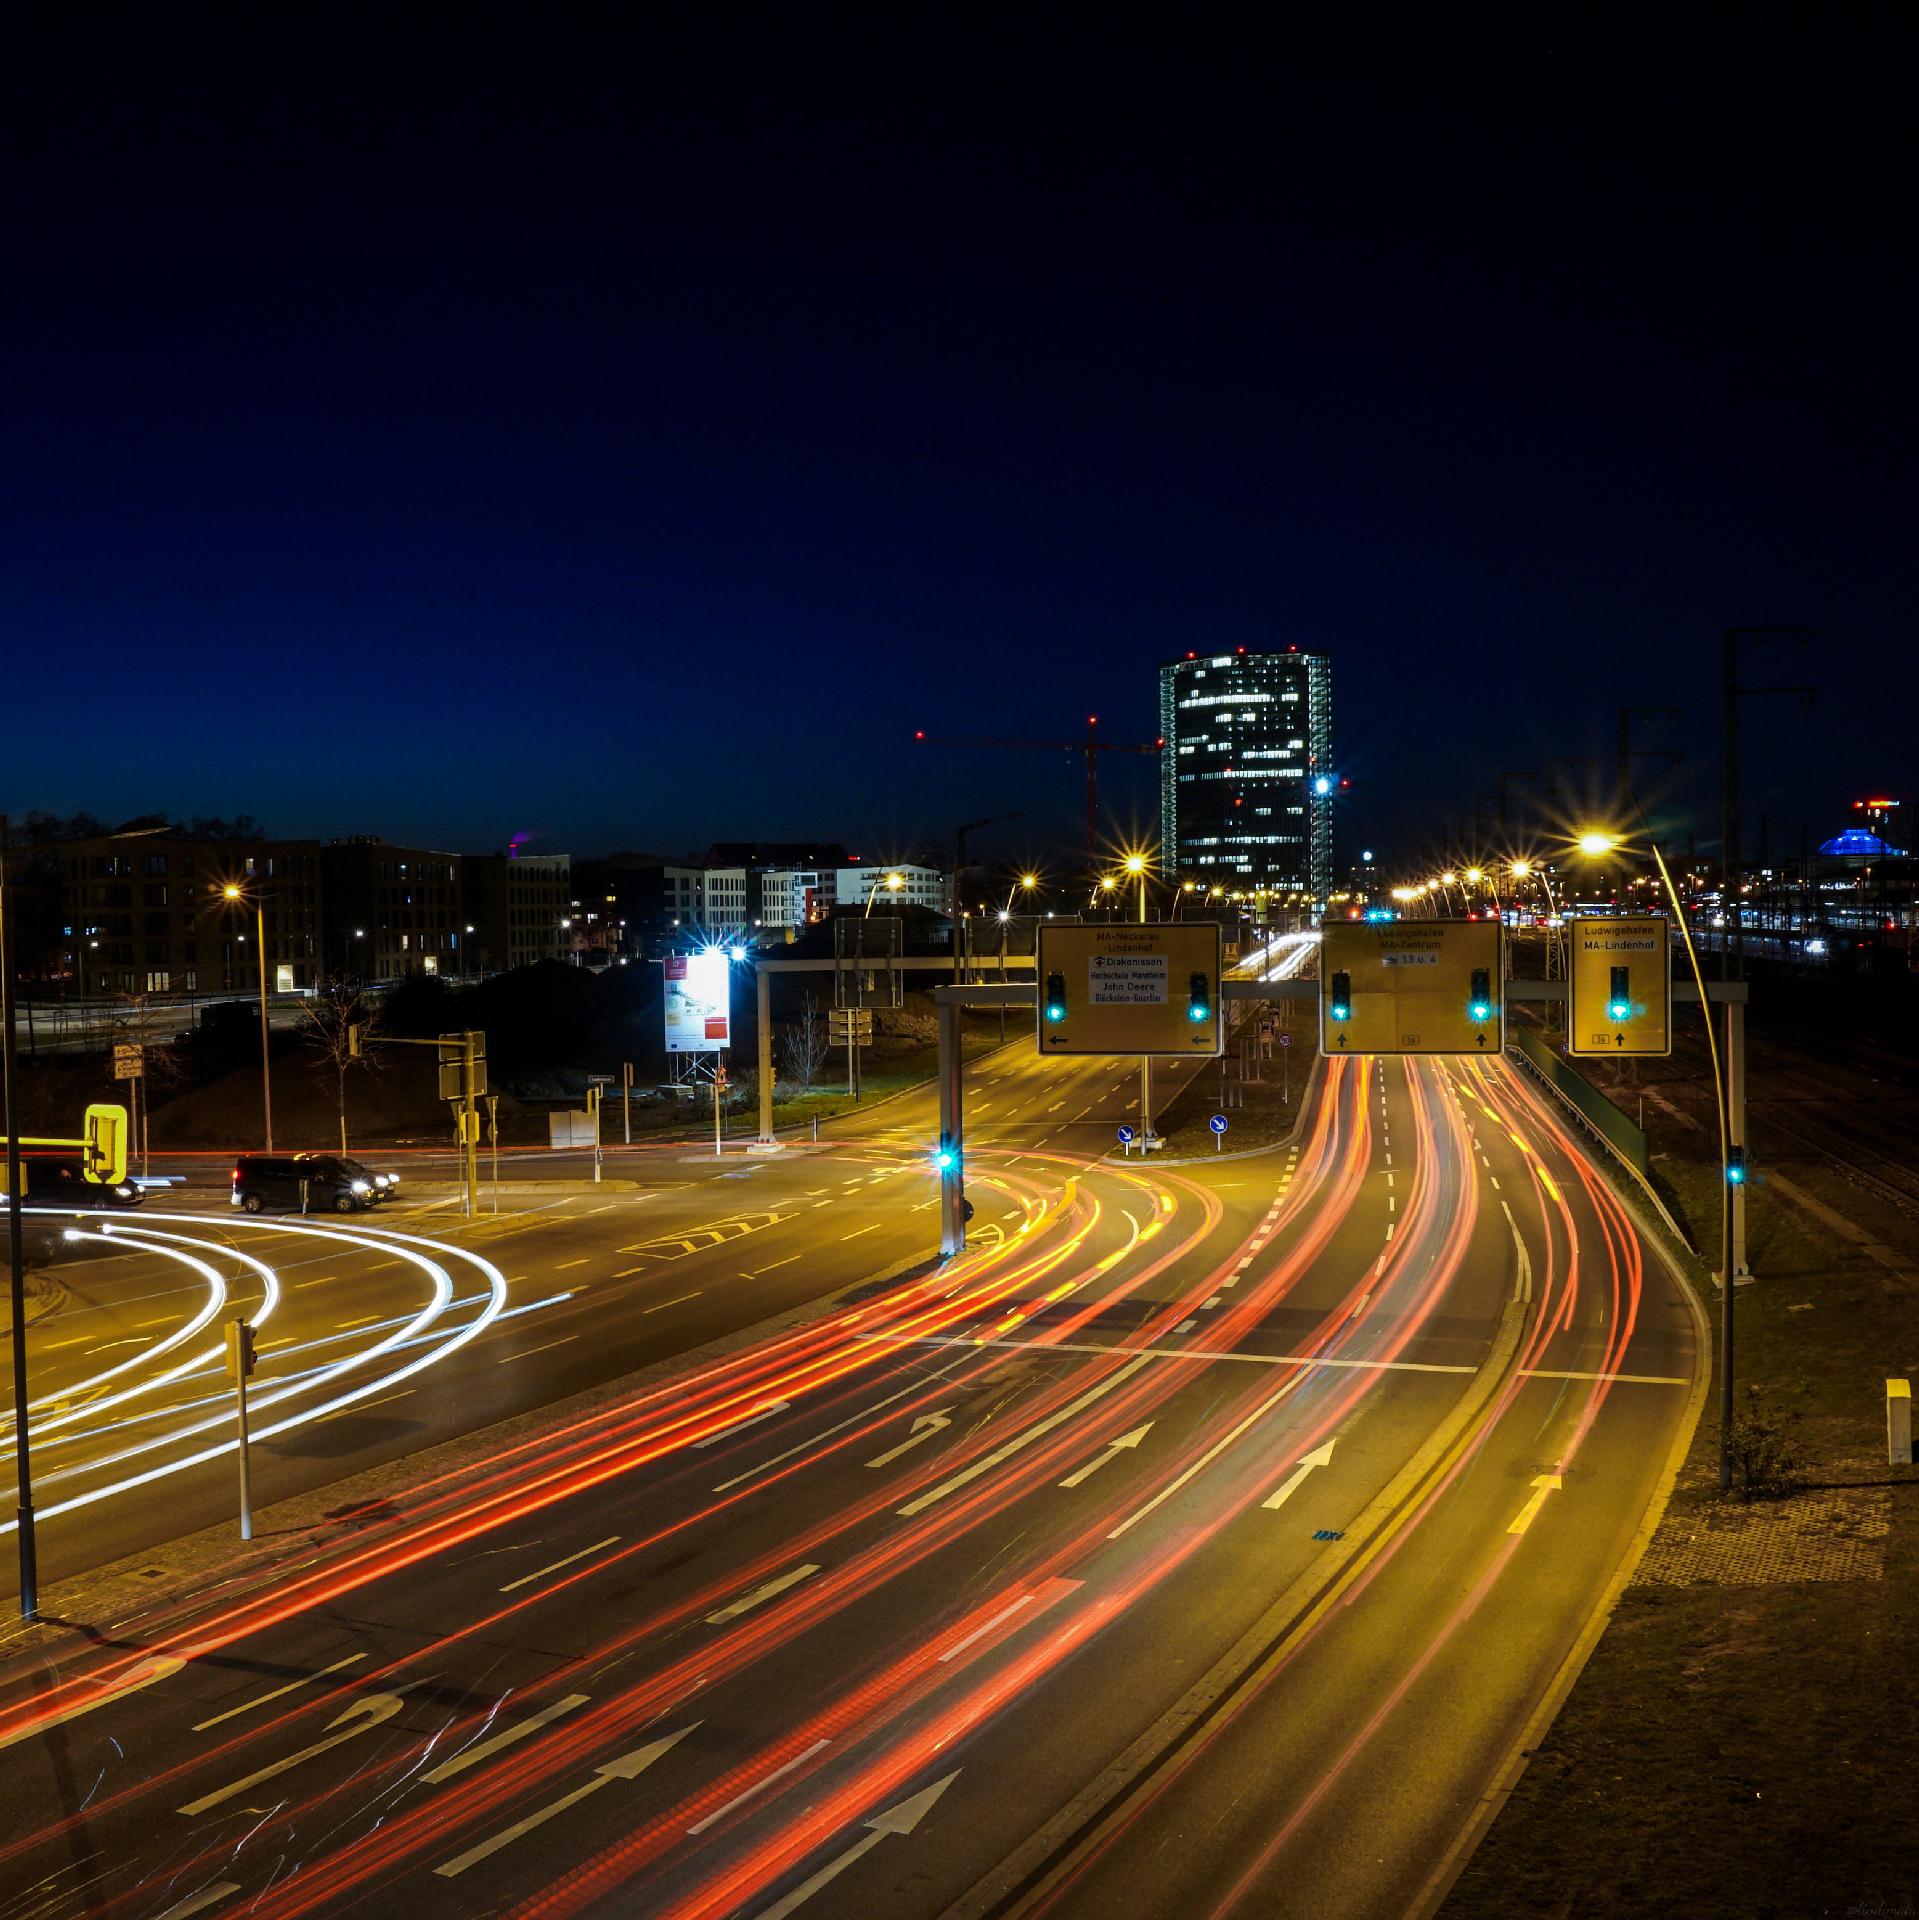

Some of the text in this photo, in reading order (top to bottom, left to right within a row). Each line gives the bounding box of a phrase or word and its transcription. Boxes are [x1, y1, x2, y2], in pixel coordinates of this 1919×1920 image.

[1584, 926, 1655, 937] Ludwigshafen
[1380, 940, 1441, 949] MA-Zentrum
[1583, 940, 1655, 951] MA-Lindenhof
[1107, 957, 1162, 966] Diakonissen
[1090, 971, 1166, 980] Hochschule Mannheim
[1103, 982, 1155, 992] John Deere
